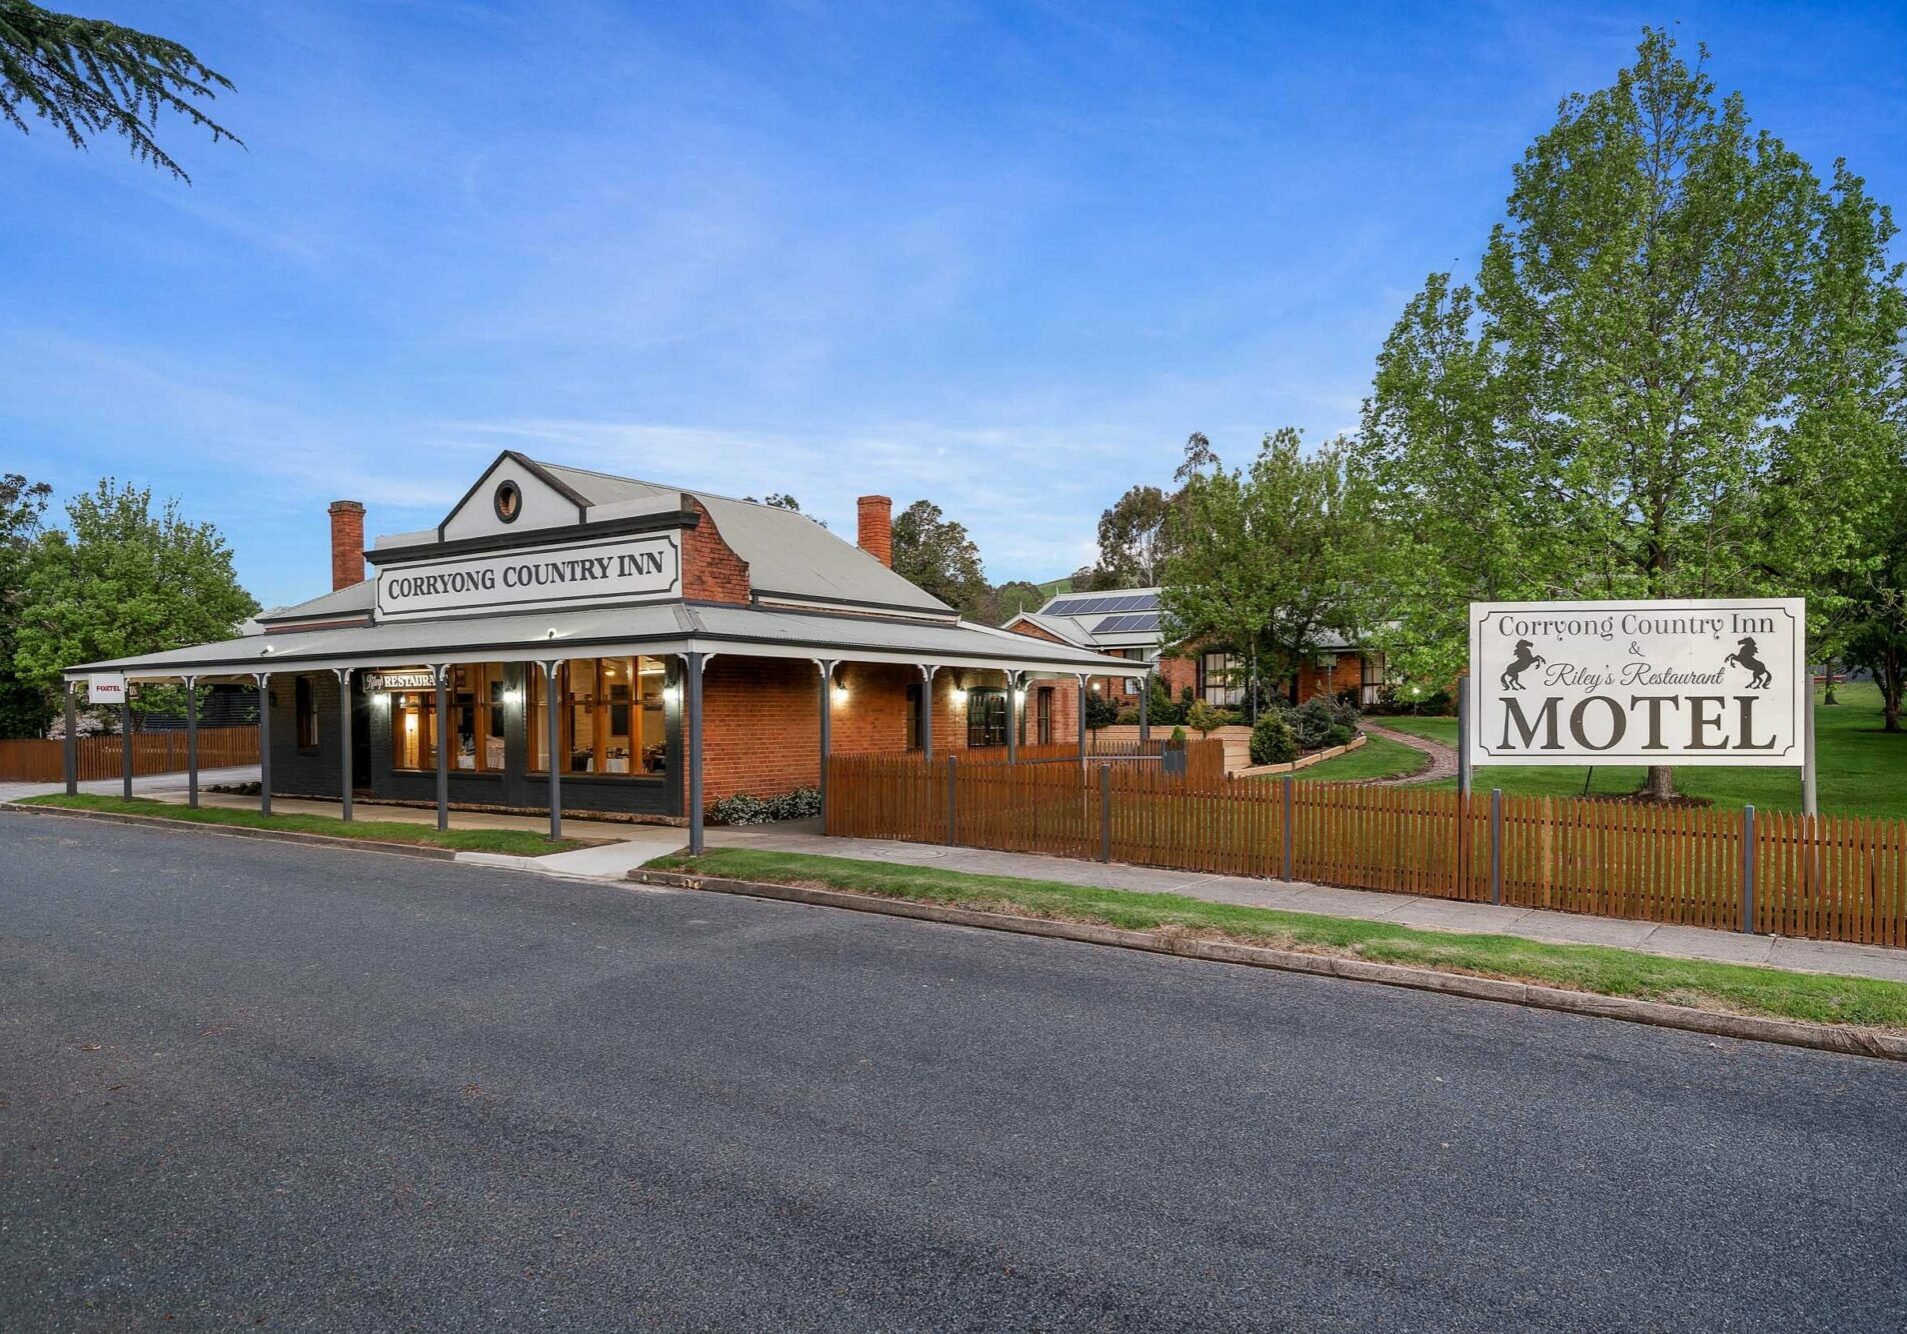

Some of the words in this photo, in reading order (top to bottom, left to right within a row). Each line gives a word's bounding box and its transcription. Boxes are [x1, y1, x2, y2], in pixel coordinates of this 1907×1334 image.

[388, 568, 496, 600] CORRYONG
[502, 556, 613, 588] COUNTRY
[616, 551, 664, 577] INN
[1499, 615, 1613, 641] Corryong
[1621, 614, 1724, 640] Country
[1731, 613, 1776, 634] Inn
[1628, 641, 1645, 657] &
[384, 674, 448, 688] RESTAURA
[1544, 662, 1614, 693] Riley's
[1620, 662, 1726, 687] Restaurant
[1496, 694, 1777, 751] MOTEL
